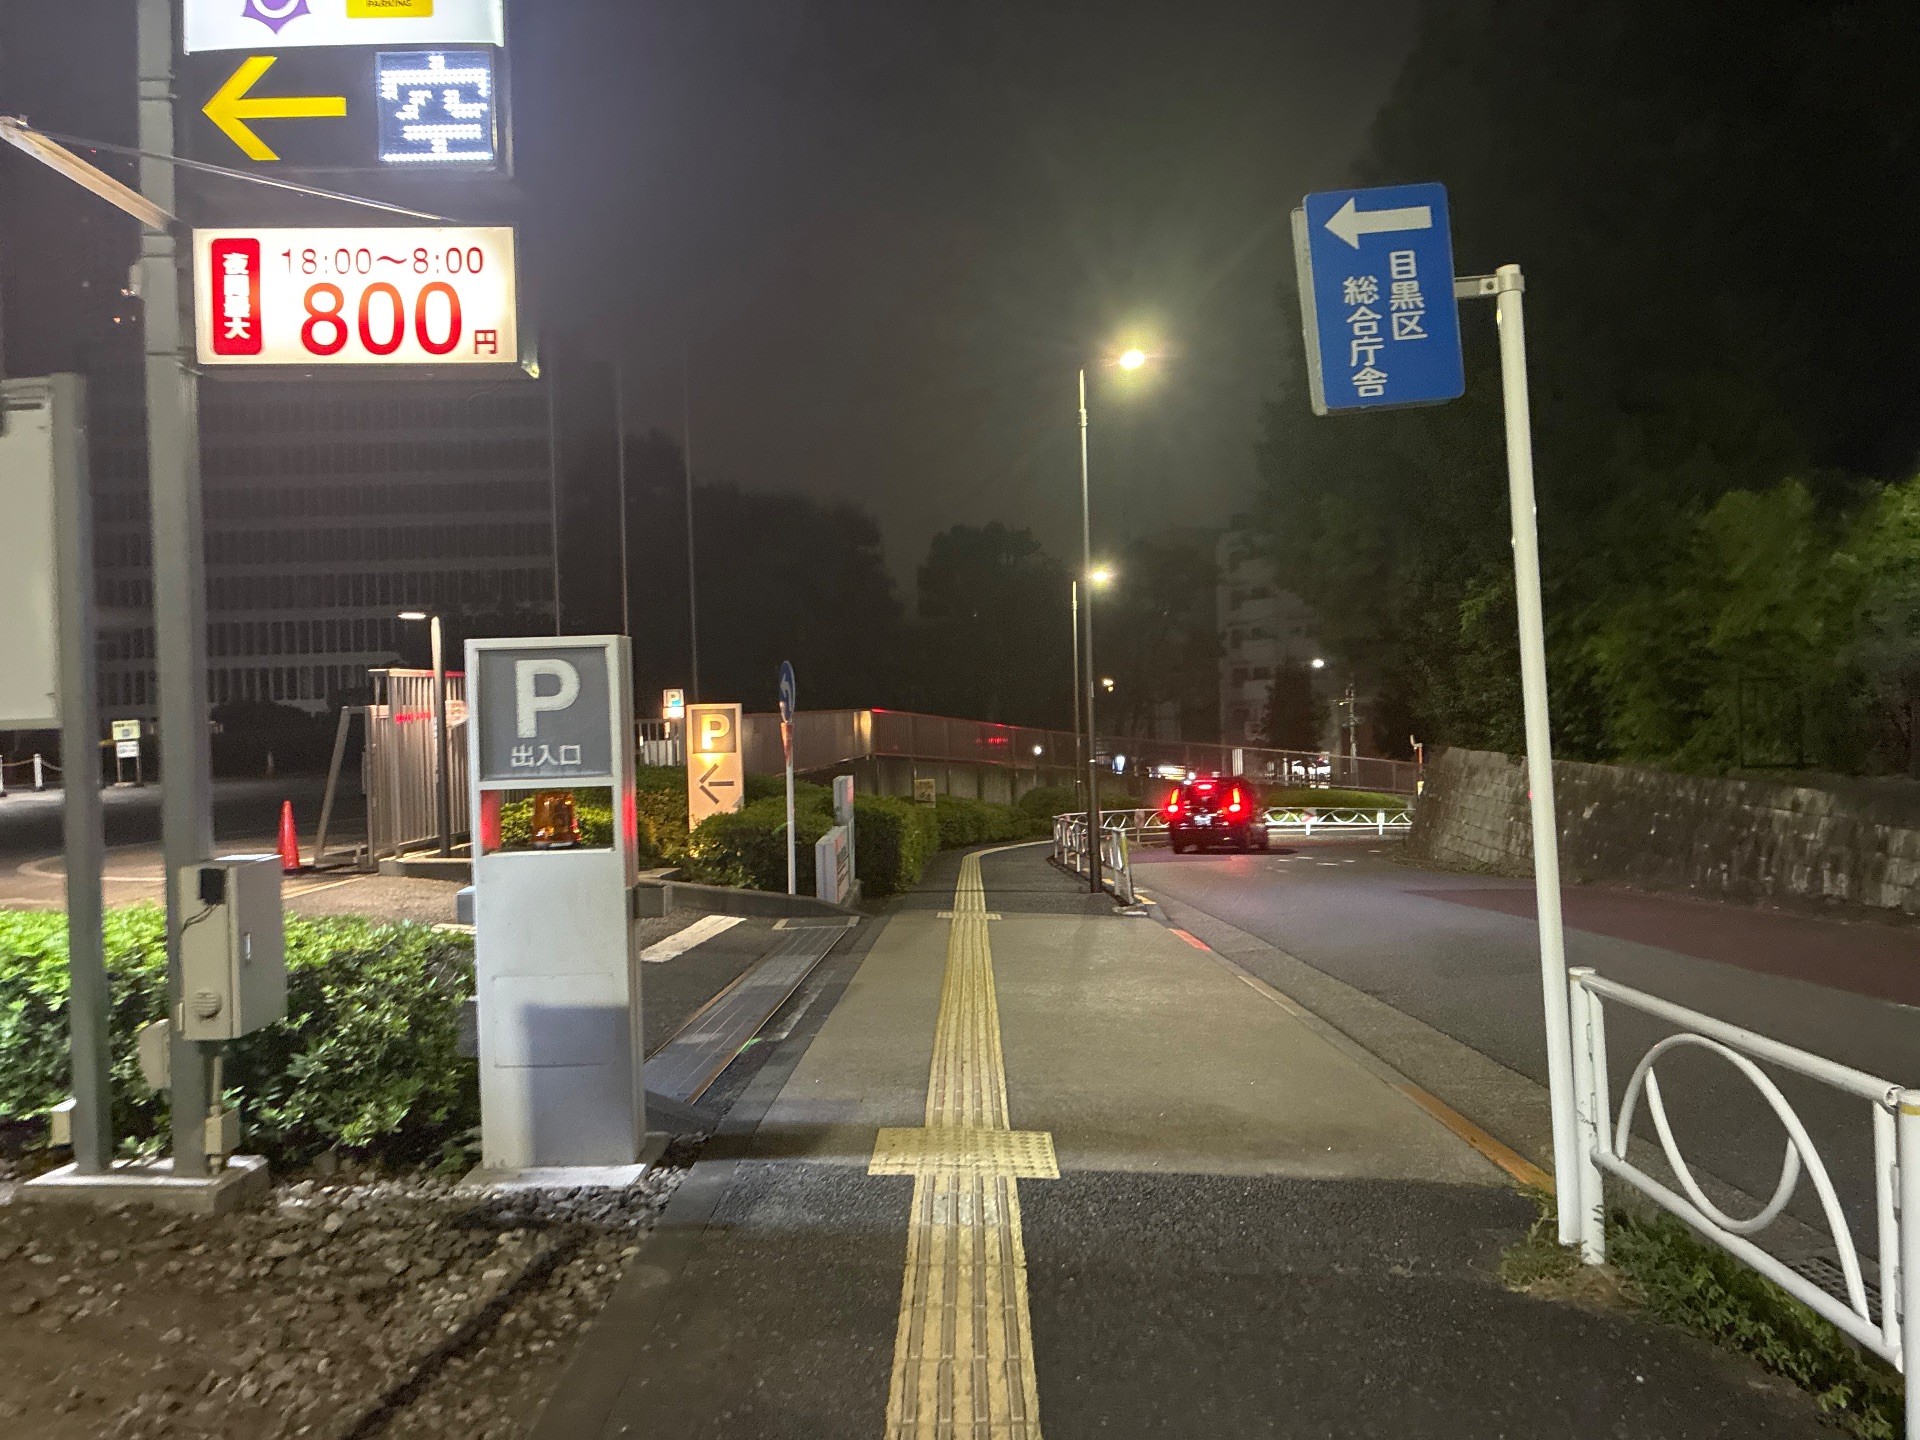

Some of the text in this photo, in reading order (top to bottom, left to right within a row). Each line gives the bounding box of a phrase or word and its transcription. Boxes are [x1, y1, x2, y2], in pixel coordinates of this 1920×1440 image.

[380, 55, 492, 161] 空
[1343, 275, 1388, 397] 総合庁舎
[1390, 250, 1428, 341] 目黒区
[515, 658, 580, 738] P
[701, 713, 730, 750] P
[511, 744, 581, 767] 出入口
